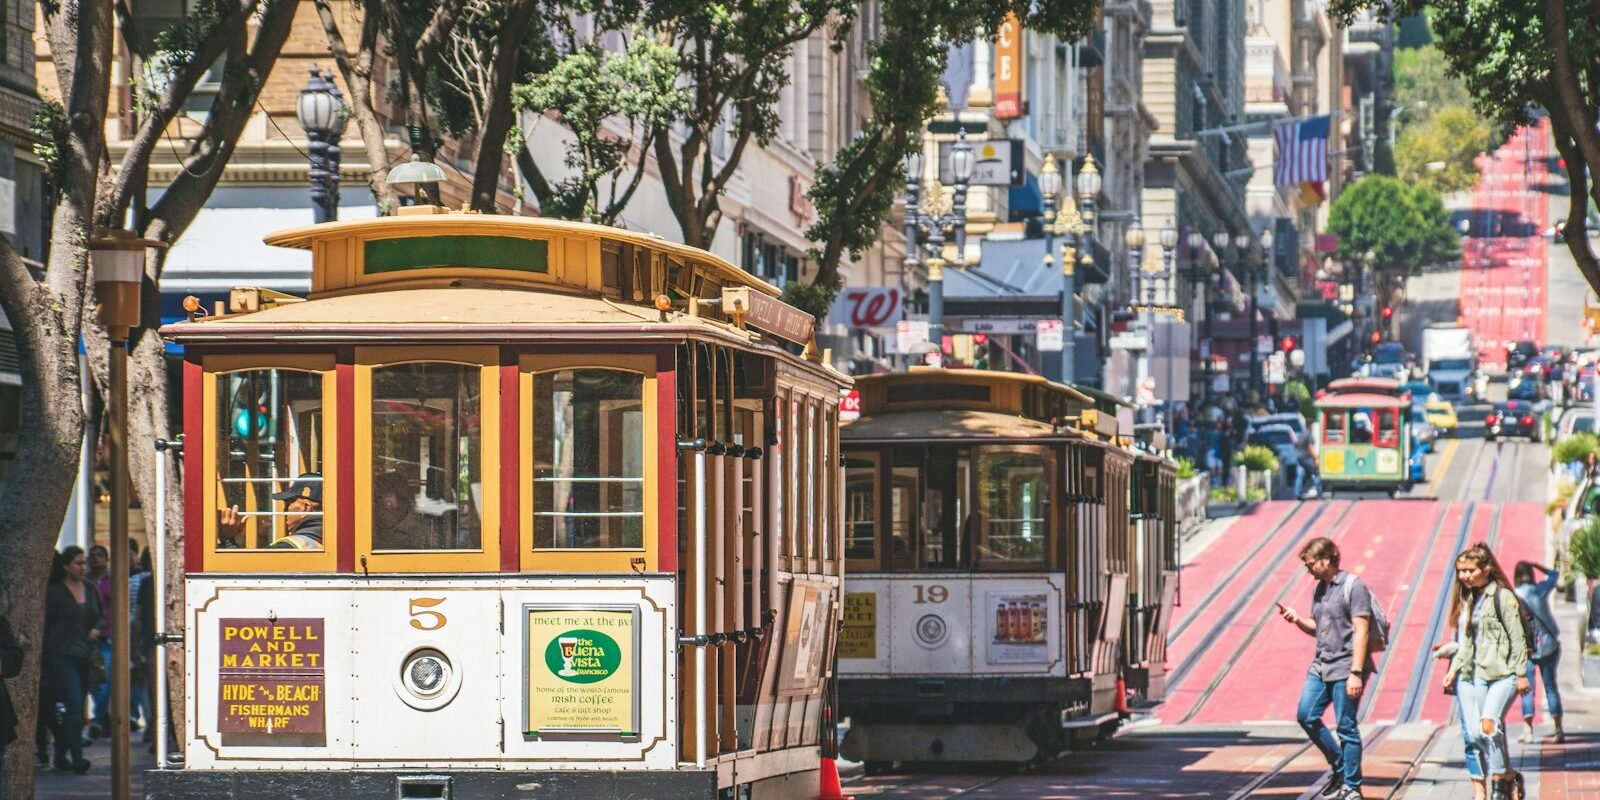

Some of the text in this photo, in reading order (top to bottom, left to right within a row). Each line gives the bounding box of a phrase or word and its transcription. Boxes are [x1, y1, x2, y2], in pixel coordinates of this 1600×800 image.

[750, 296, 773, 324] OWELL
[847, 289, 899, 326] W
[912, 584, 949, 604] 19
[847, 598, 872, 606] ELL
[408, 597, 447, 631] 5
[534, 617, 561, 626] meet
[564, 617, 580, 626] me
[597, 616, 615, 626] the
[224, 626, 318, 640] POWELL
[249, 641, 296, 652] AND
[577, 638, 593, 646] the
[223, 653, 320, 667] MARKET
[223, 684, 255, 700] HYDE
[276, 685, 319, 701] BEACH
[557, 686, 565, 694] of
[230, 704, 310, 716] FISHERMANS
[248, 717, 290, 728] WHARF
